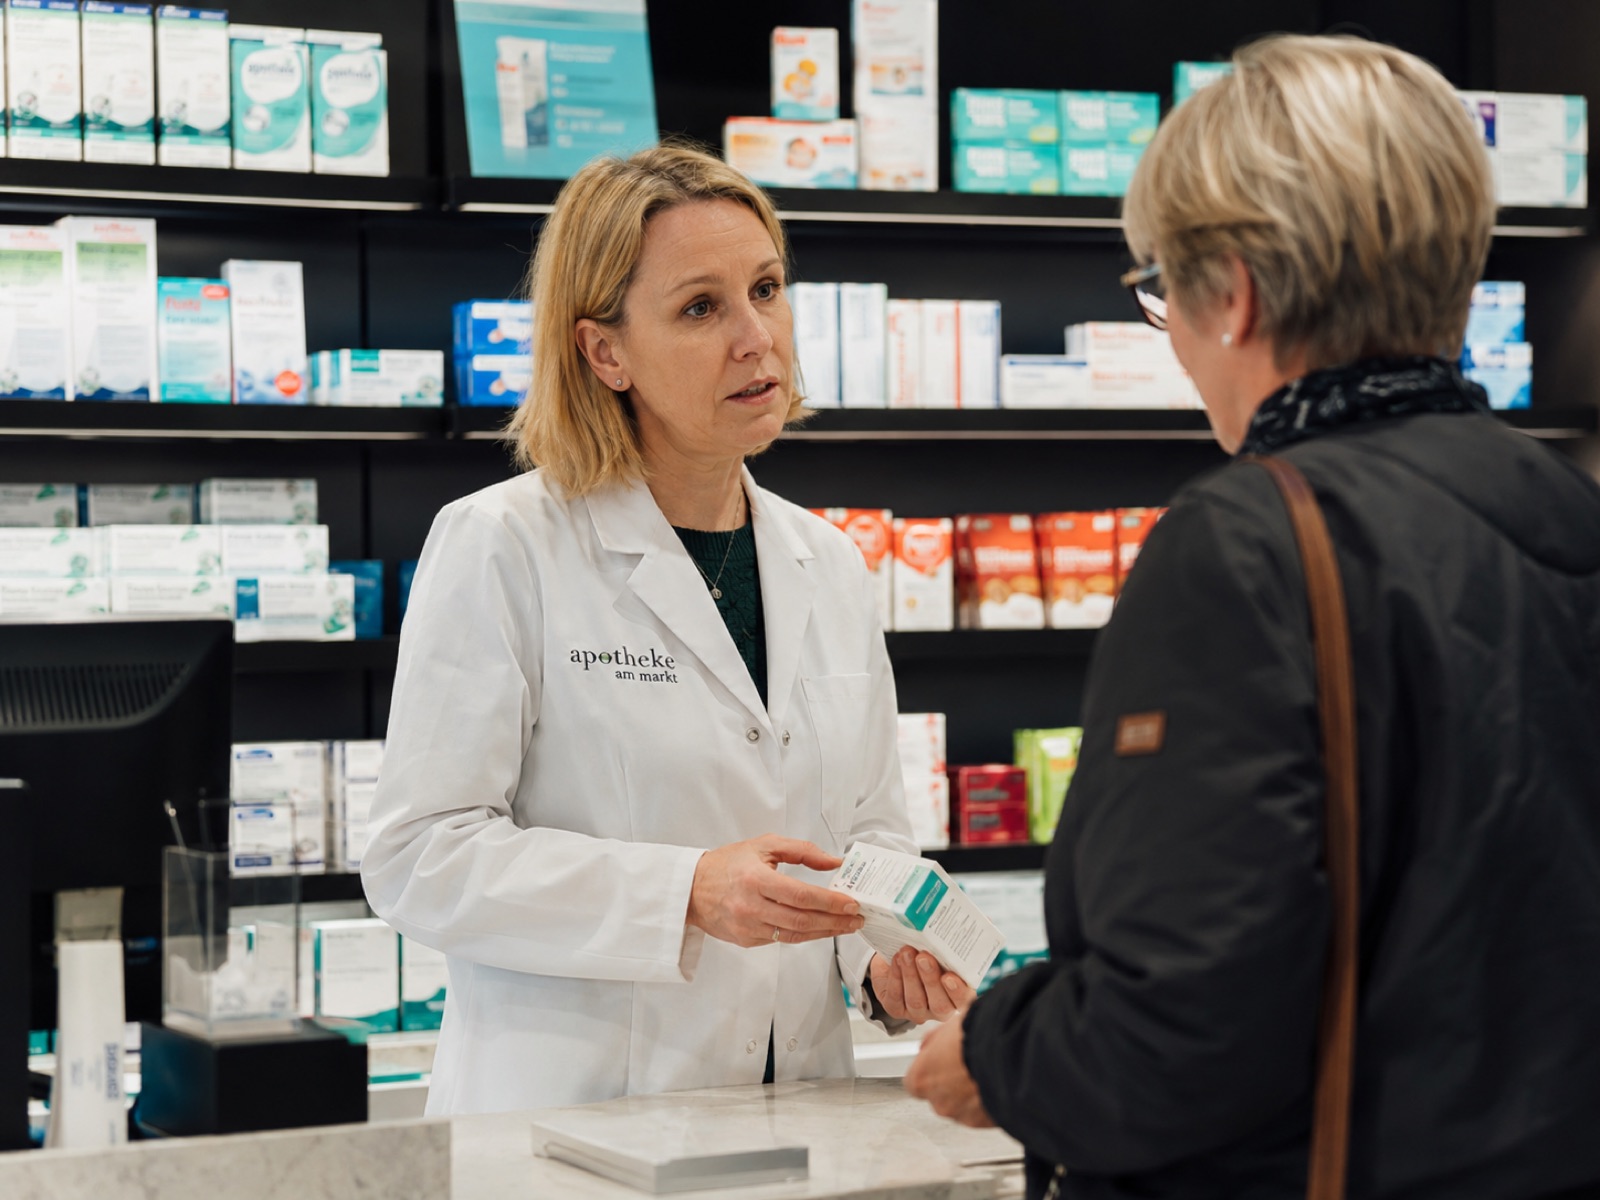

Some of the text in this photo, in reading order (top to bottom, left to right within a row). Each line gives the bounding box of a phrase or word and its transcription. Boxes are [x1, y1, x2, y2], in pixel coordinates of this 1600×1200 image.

[570, 646, 675, 671] apotheke
[615, 670, 678, 683] am markt
